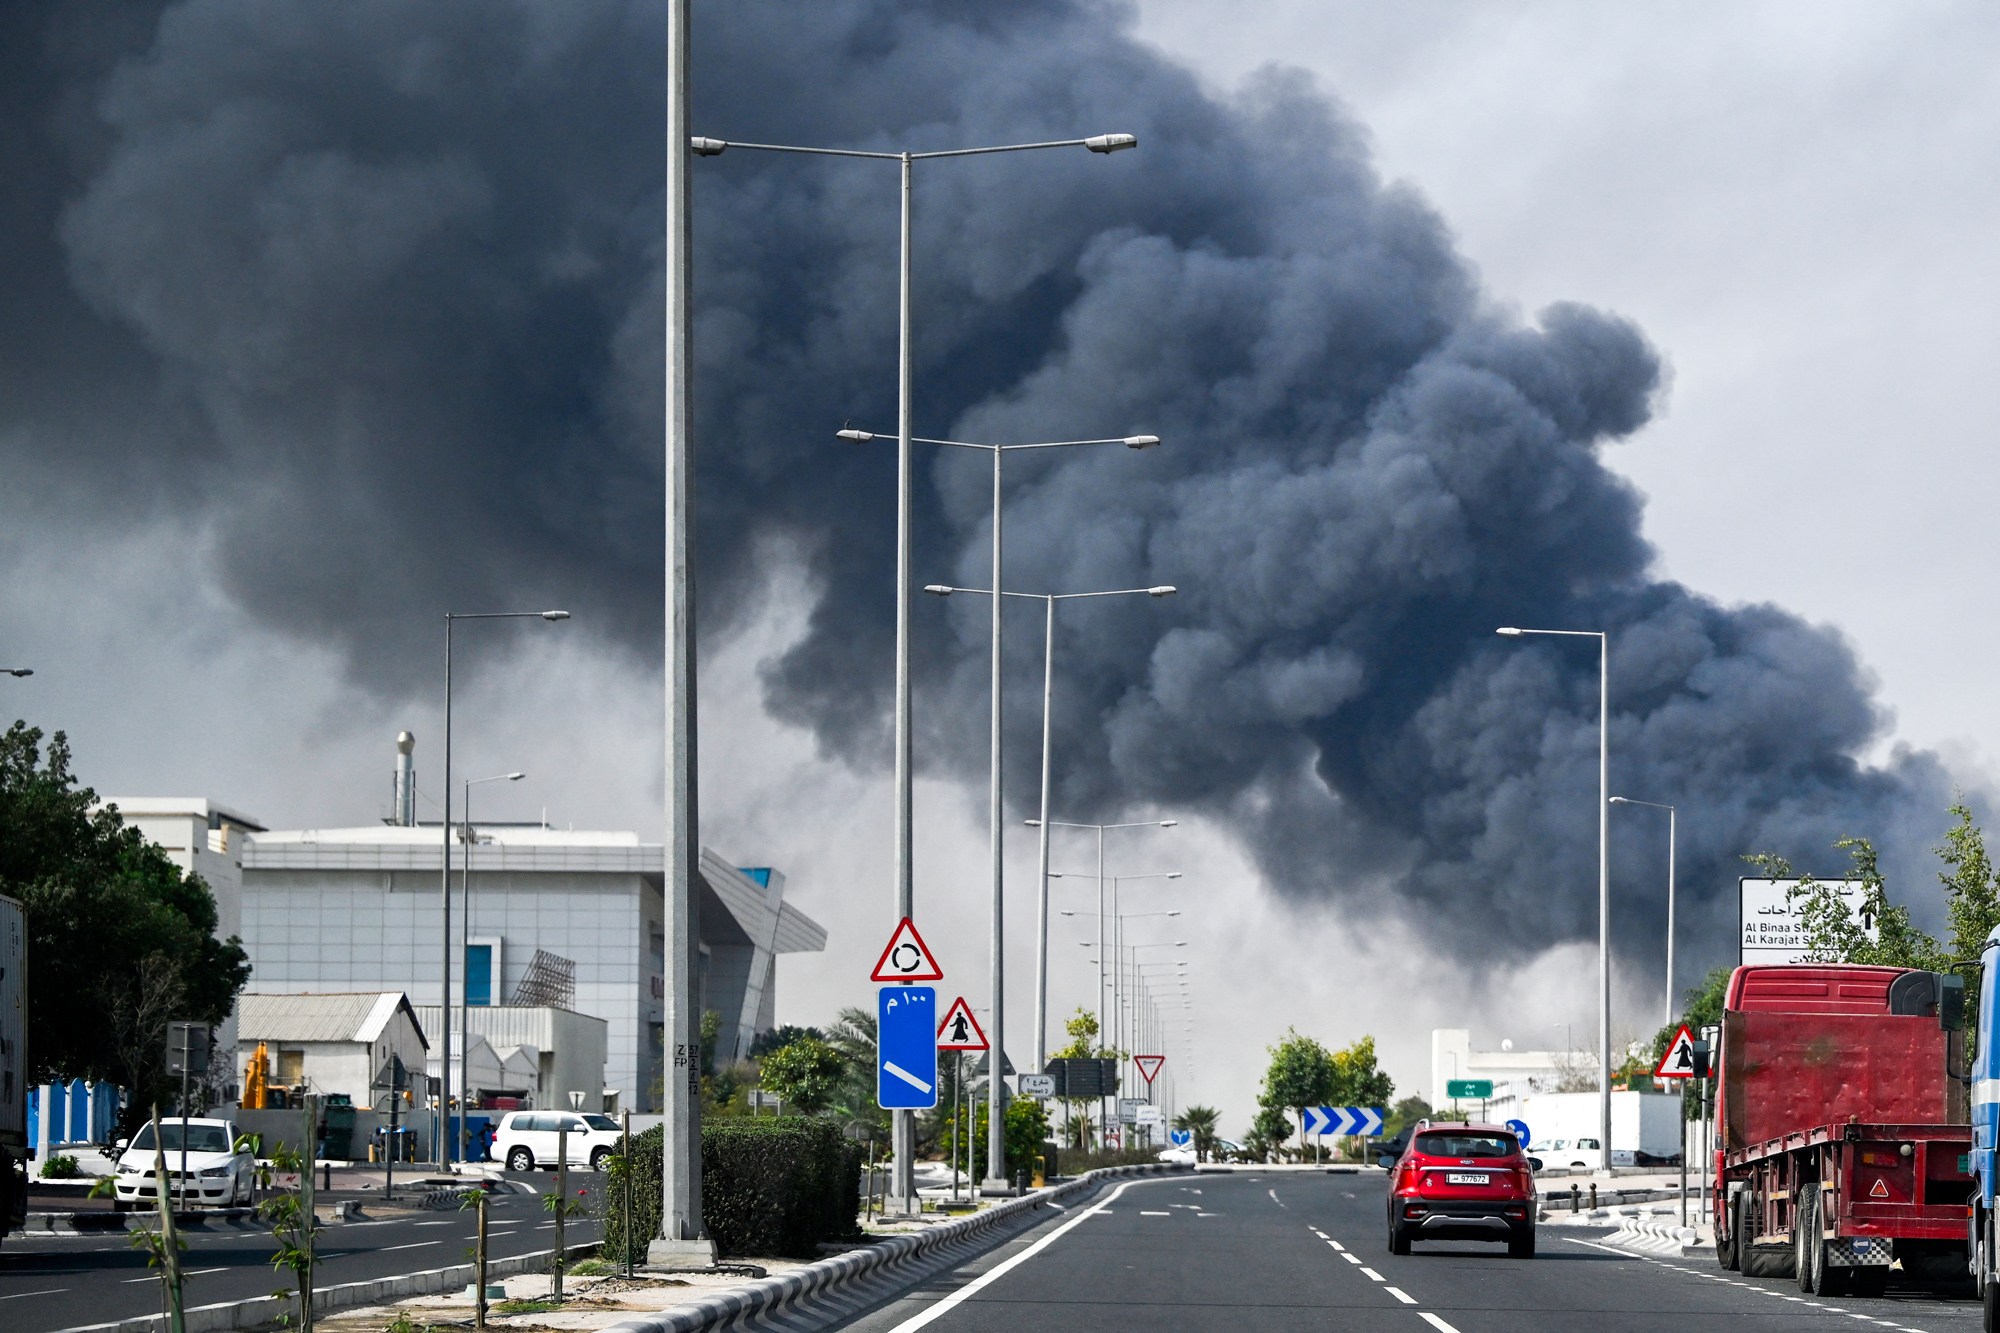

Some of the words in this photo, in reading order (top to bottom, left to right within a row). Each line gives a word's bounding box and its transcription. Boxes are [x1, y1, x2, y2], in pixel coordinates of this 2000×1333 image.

[1745, 922, 1756, 933] Al
[1760, 922, 1791, 933] Binaa
[1745, 934, 1756, 944] Al
[1760, 934, 1800, 946] Karajat
[678, 1045, 684, 1055] Z
[675, 1058, 687, 1067] FP
[691, 1058, 696, 1067] 2
[1461, 1175, 1486, 1183] 977672
